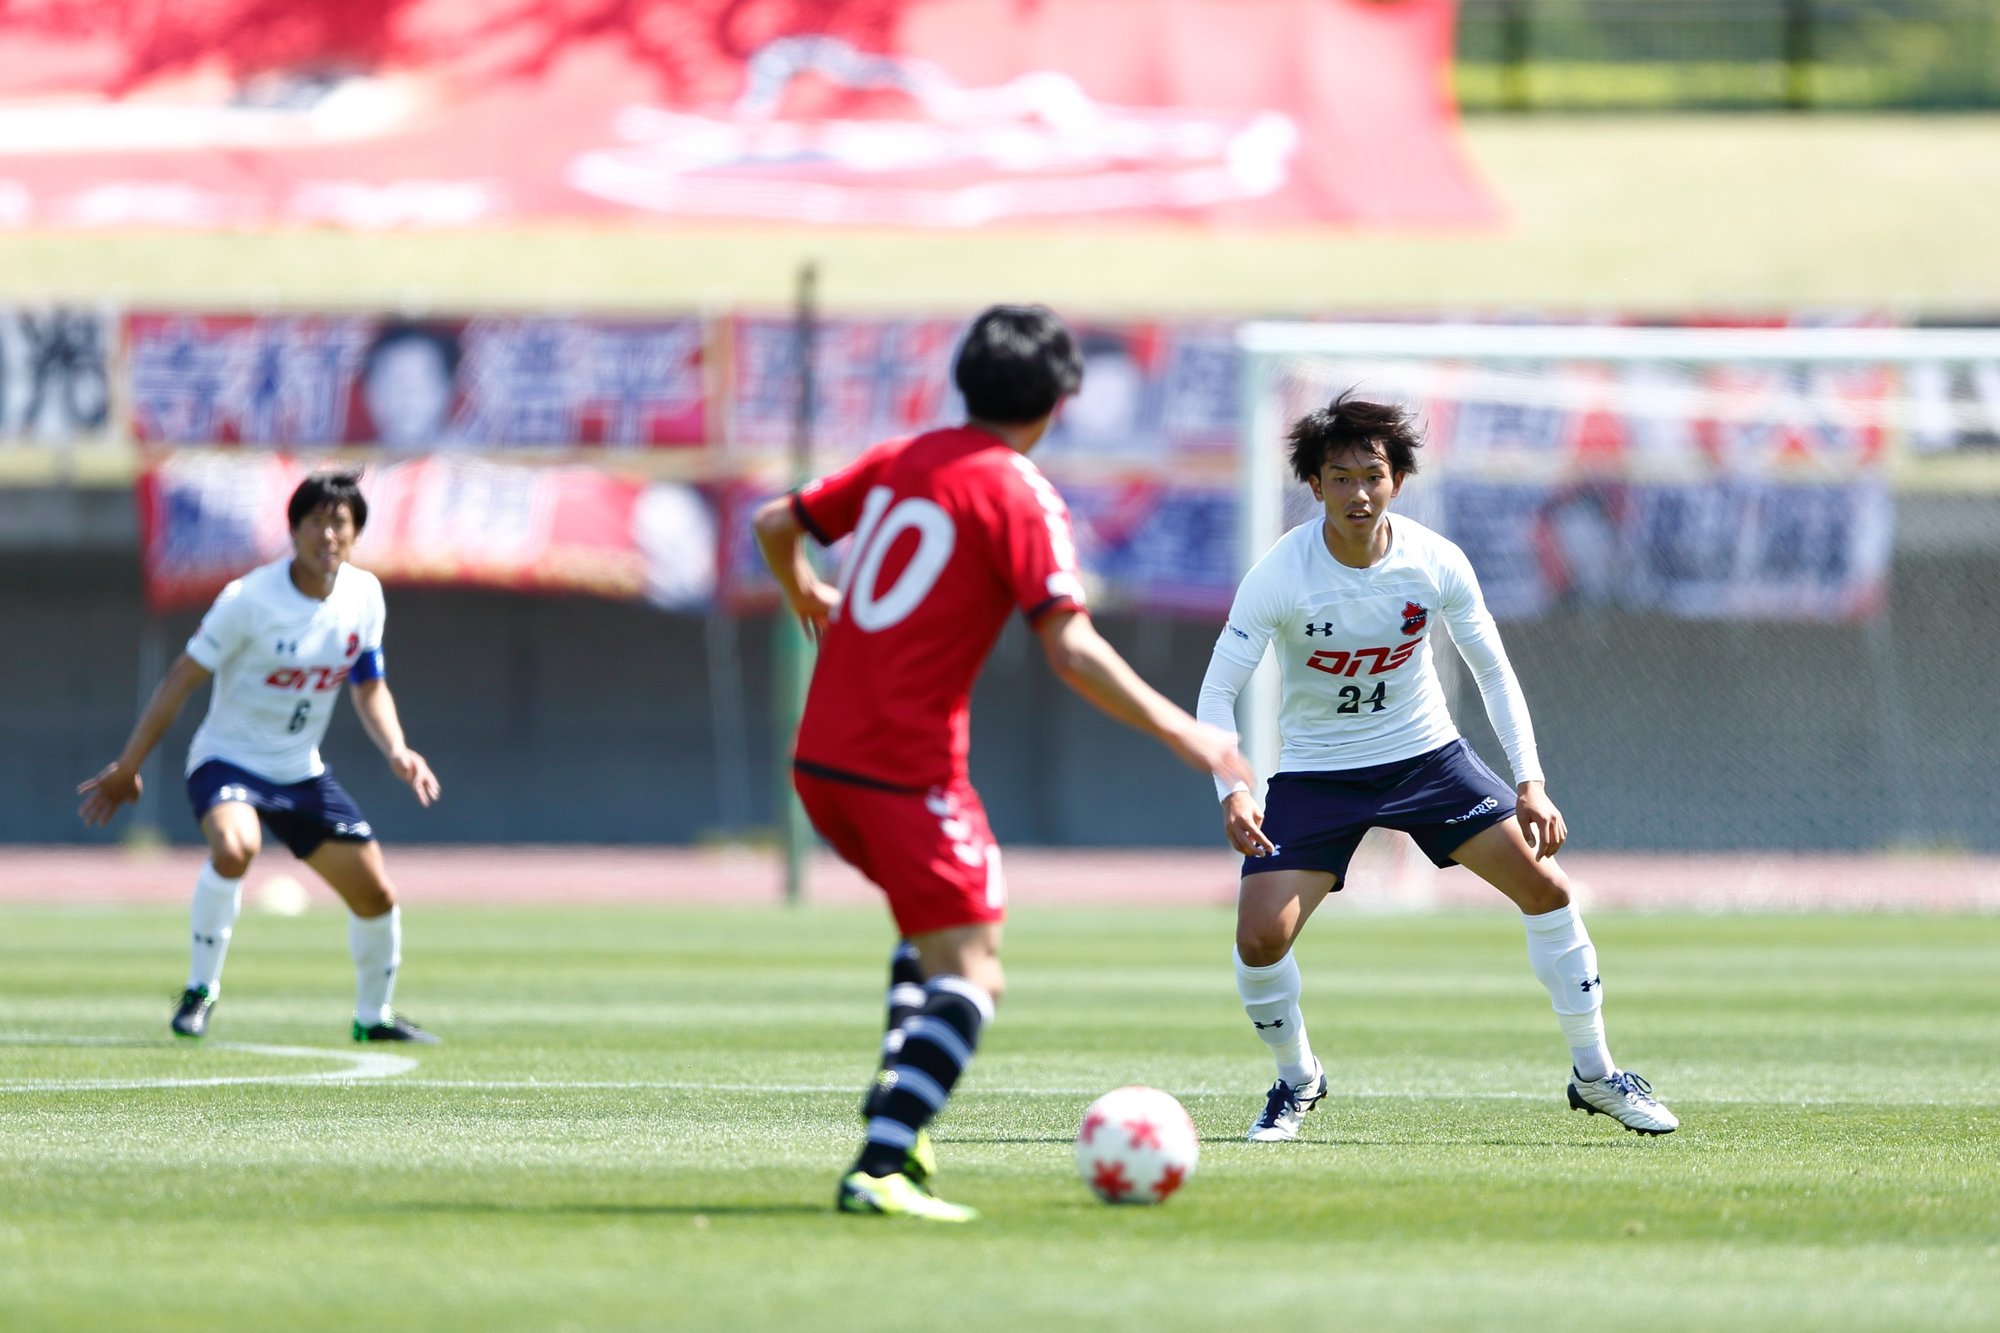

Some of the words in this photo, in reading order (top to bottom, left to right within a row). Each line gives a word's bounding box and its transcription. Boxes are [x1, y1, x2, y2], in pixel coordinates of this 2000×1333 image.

[829, 484, 957, 633] 10
[1337, 681, 1387, 714] 24
[286, 699, 311, 735] 6
